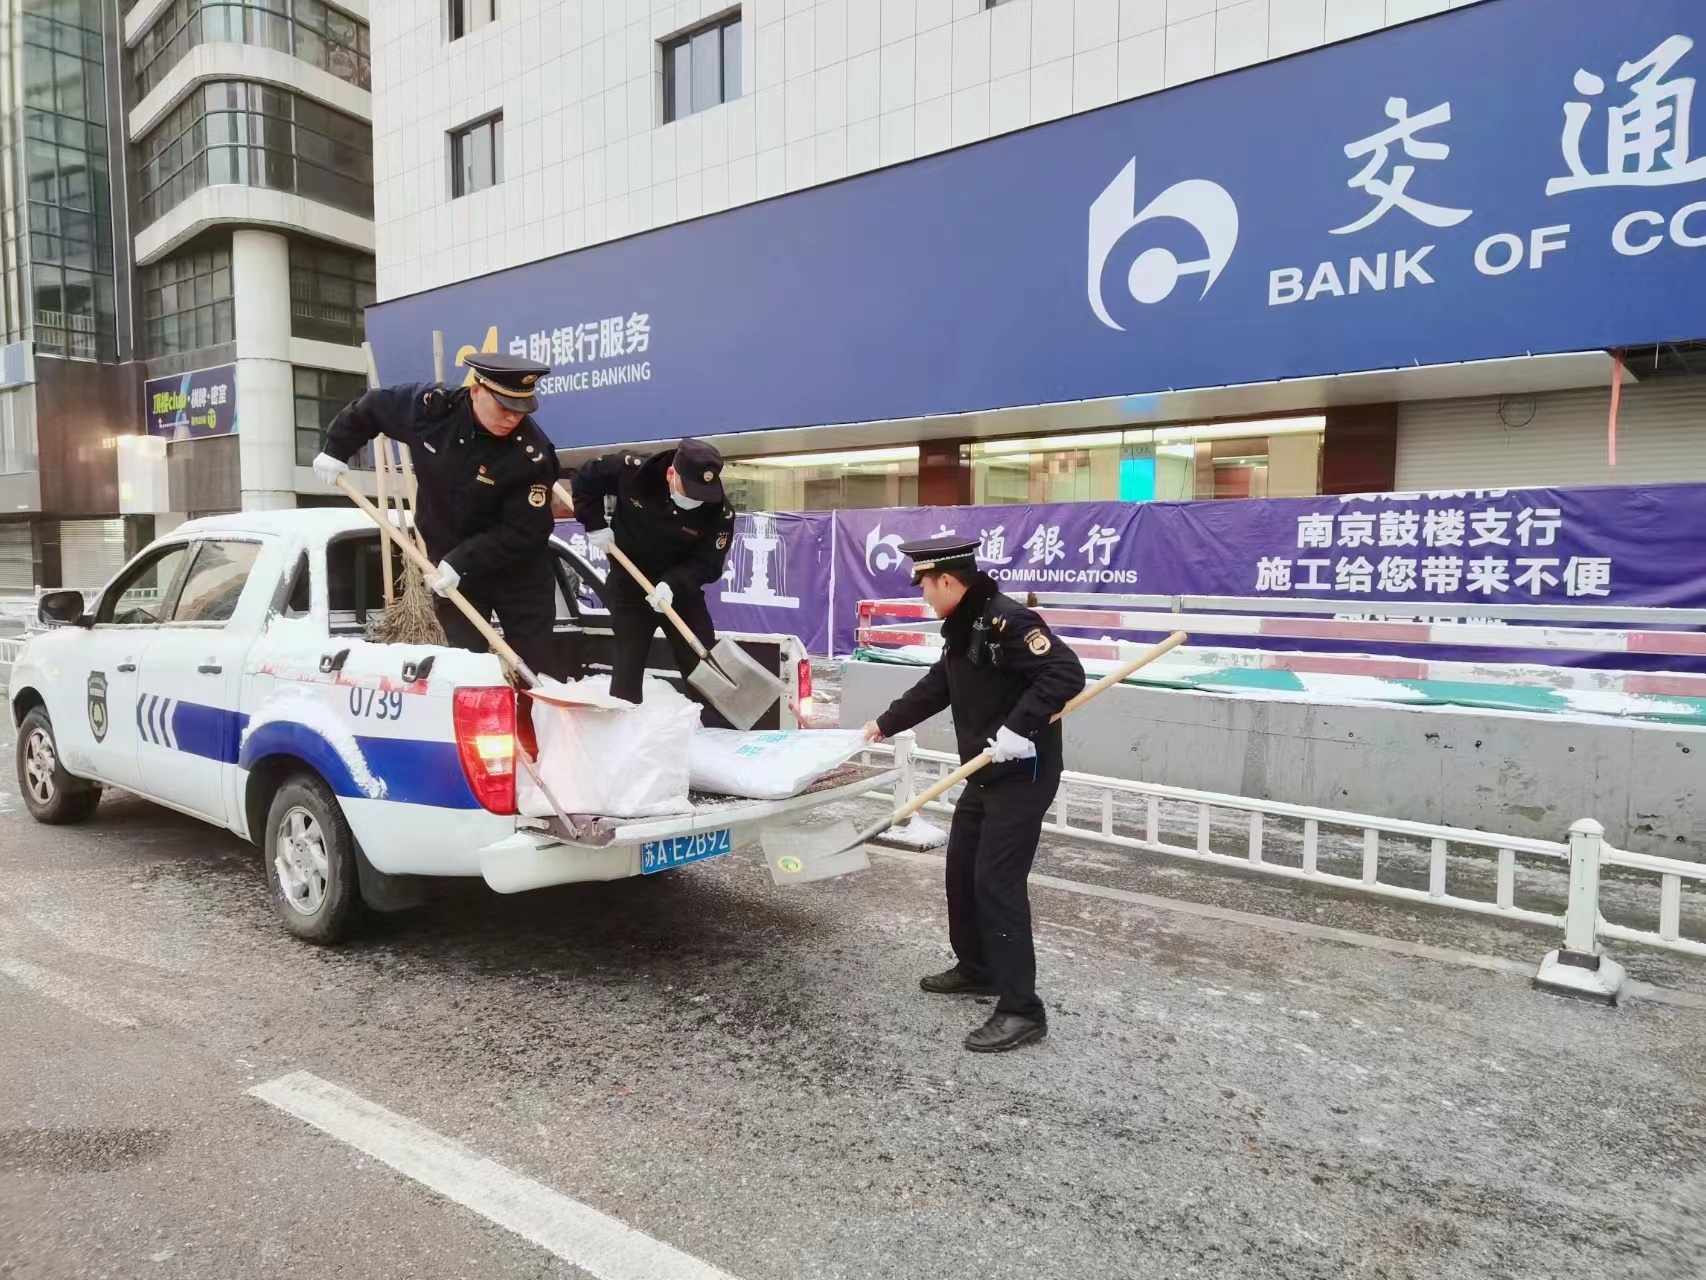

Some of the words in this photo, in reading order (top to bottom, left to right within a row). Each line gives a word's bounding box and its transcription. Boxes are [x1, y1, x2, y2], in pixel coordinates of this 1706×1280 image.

[1269, 245, 1436, 306] BANK
[1474, 225, 1570, 276] OF
[1611, 201, 1706, 256] CO
[536, 371, 589, 395] -SERVICE
[592, 361, 651, 388] BANKING
[931, 524, 1120, 566] 通銀行
[1297, 506, 1562, 549] 南京鼓楼支行
[988, 568, 1138, 584] COMMUNICATIONS
[1256, 556, 1612, 596] 施工给您带来不便
[350, 687, 403, 720] 0739
